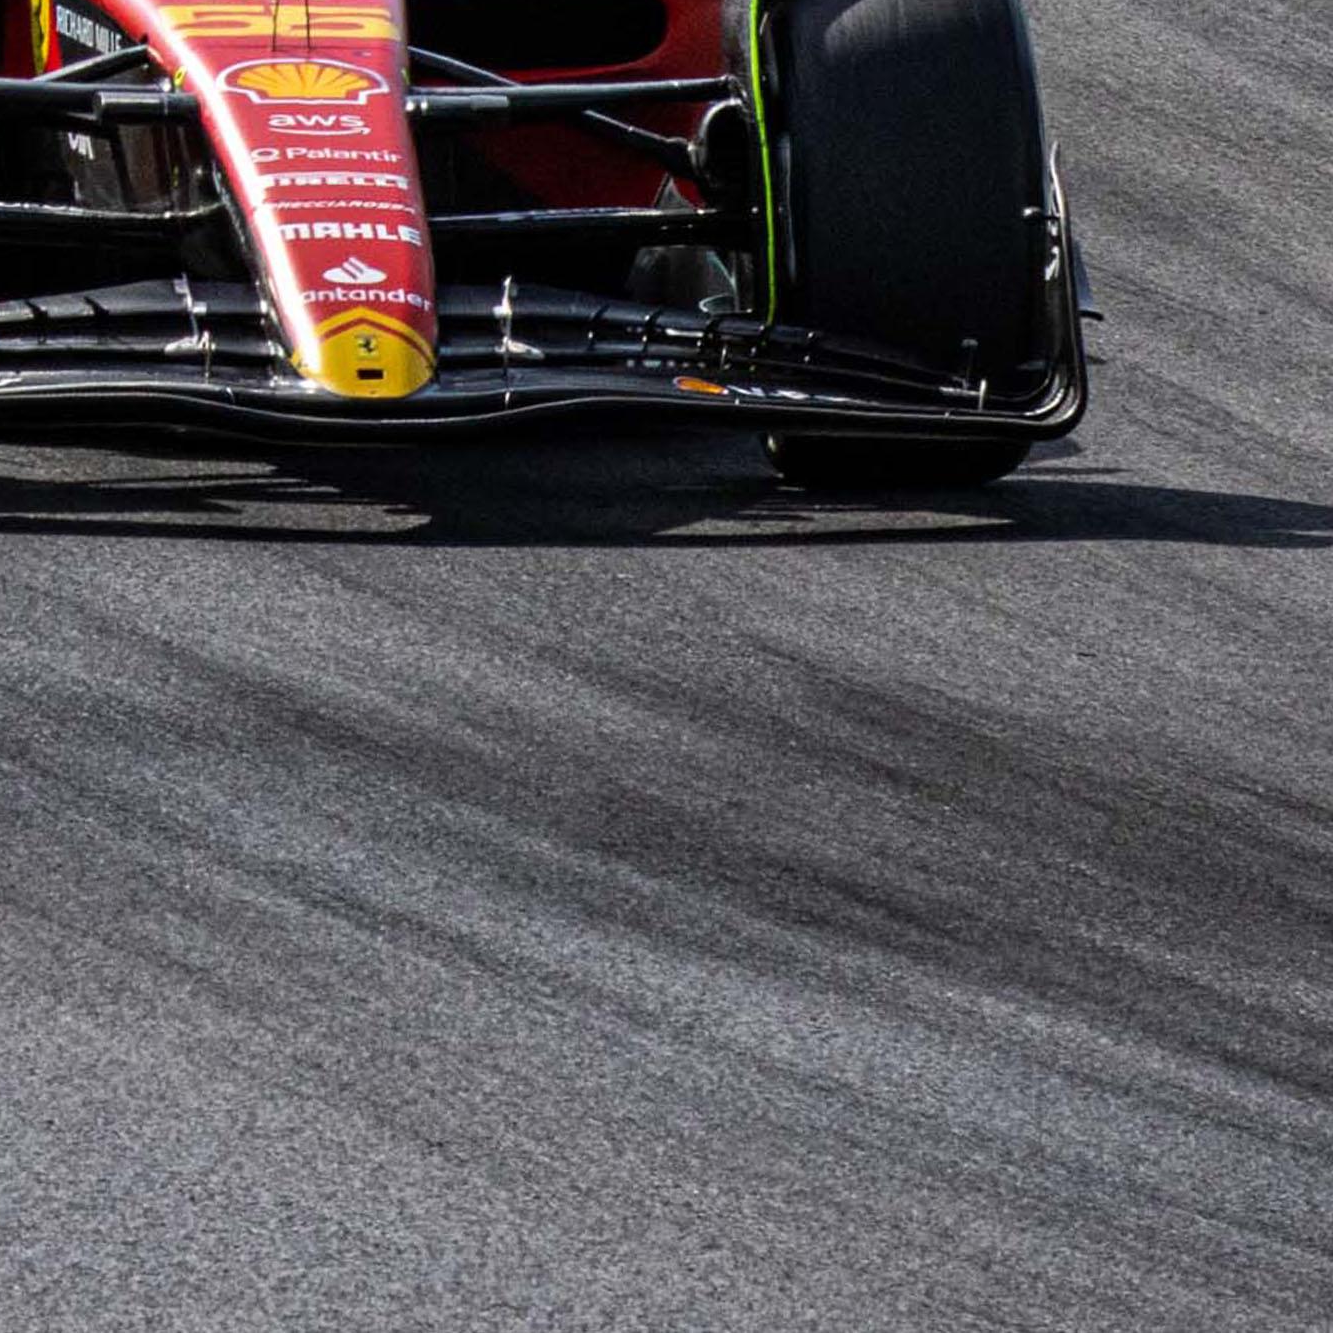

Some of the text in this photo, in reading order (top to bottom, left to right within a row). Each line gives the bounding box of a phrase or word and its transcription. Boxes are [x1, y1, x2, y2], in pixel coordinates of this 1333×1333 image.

[158, 4, 399, 40] 55
[269, 113, 364, 129] aws
[286, 146, 403, 163] Palantir
[278, 222, 423, 247] MAHLE
[296, 287, 433, 312] antander
